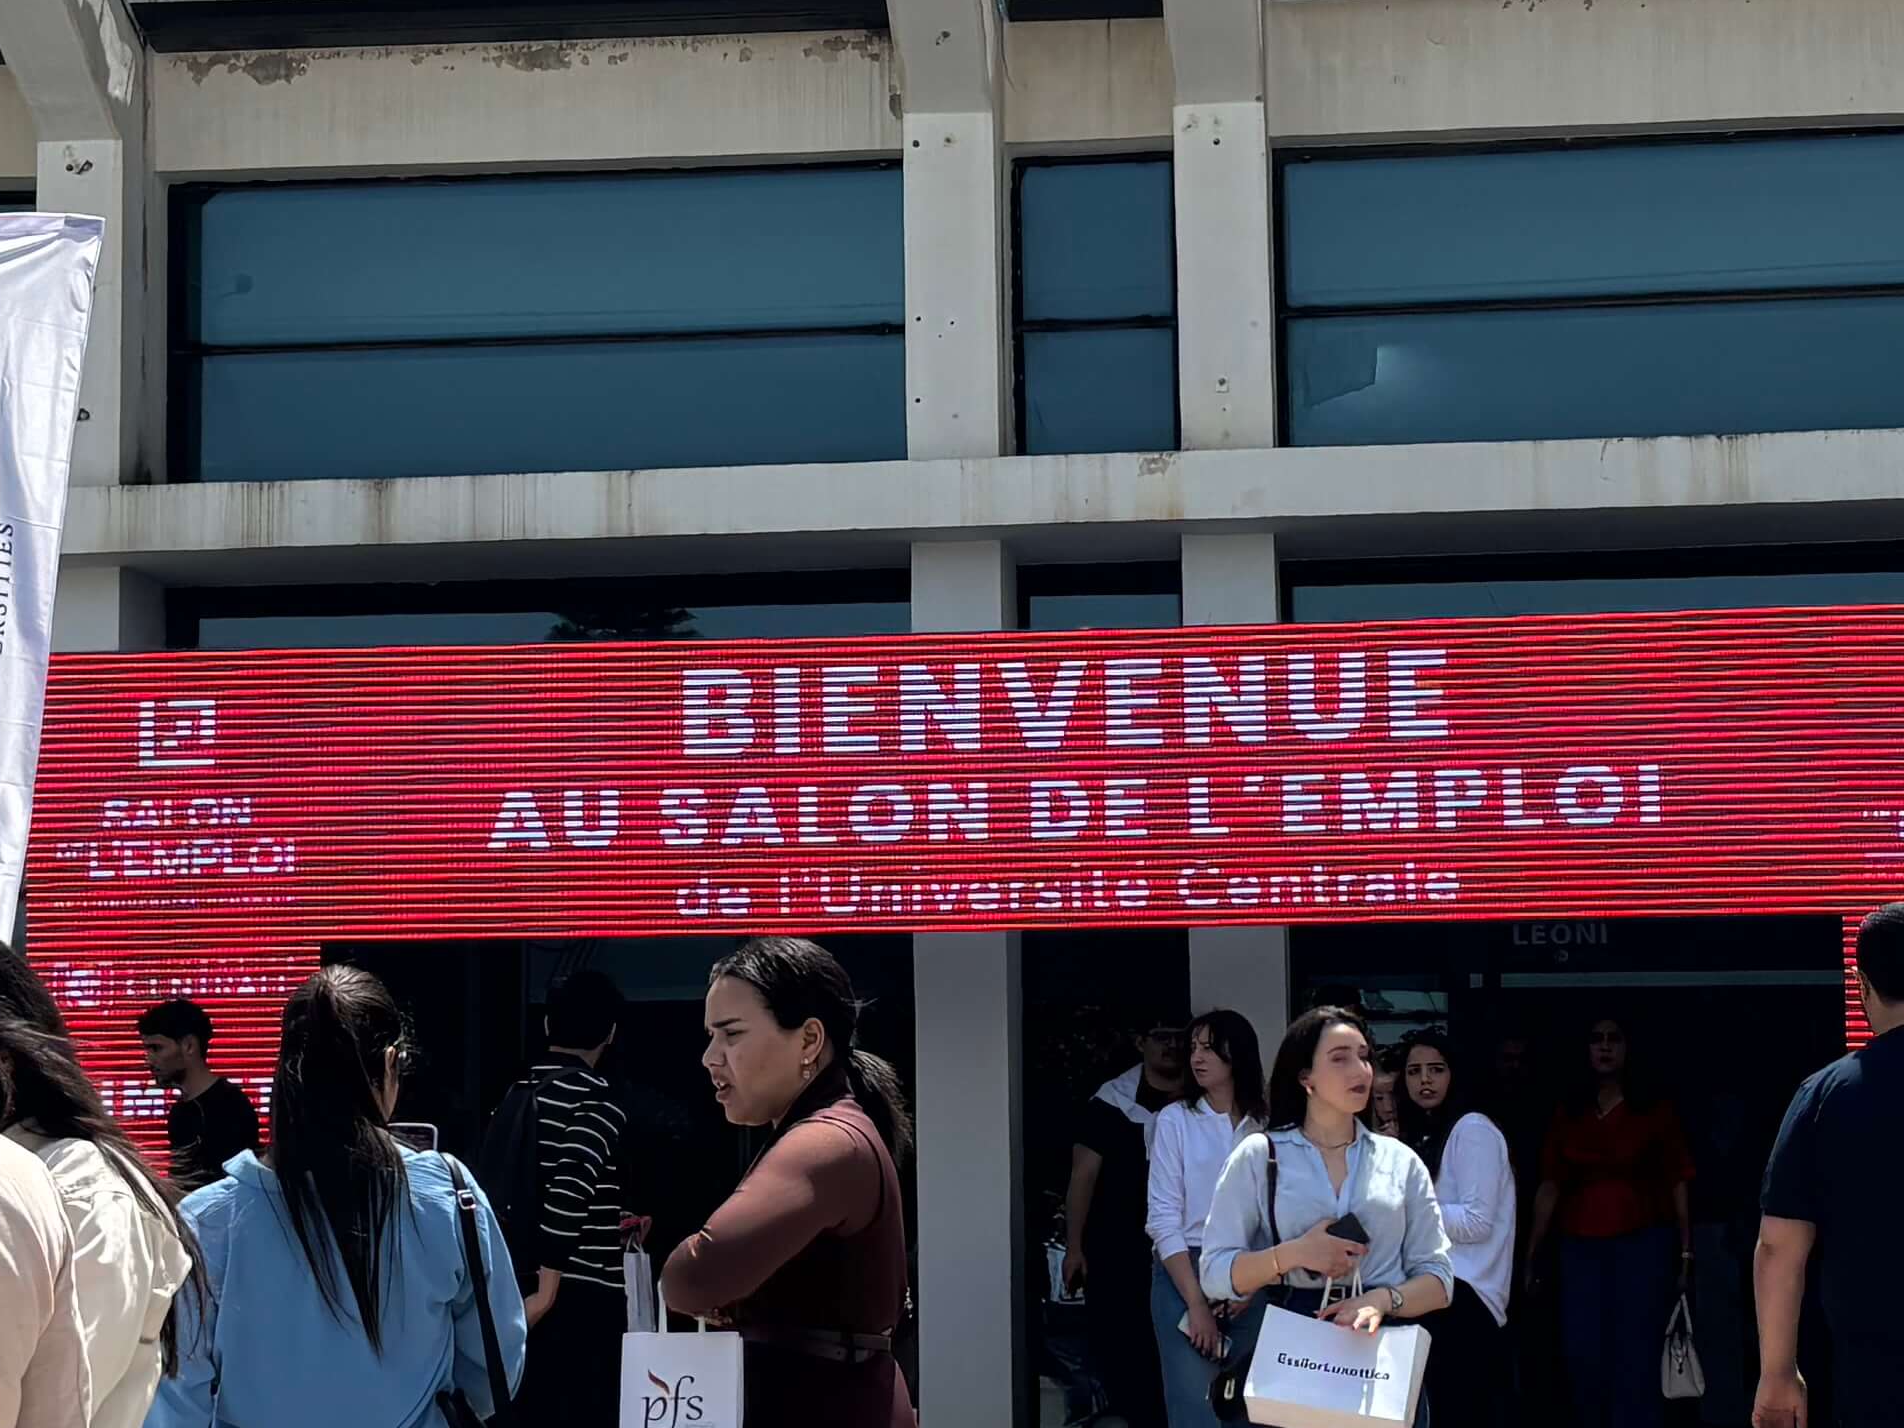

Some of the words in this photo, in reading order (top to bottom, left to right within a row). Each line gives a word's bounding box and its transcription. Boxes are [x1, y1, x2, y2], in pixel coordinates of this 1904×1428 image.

[682, 649, 1449, 755] BIENVENUE
[101, 797, 252, 828] SALON
[487, 790, 621, 850] AU
[659, 782, 989, 845] SALON
[1030, 778, 1148, 838] DE
[1188, 763, 1661, 834] L'EMPLOI
[676, 876, 752, 916] de
[1177, 860, 1460, 906] Centrale
[1512, 922, 1609, 945] LEONI
[1277, 1352, 1391, 1381] EssilorLuxottica
